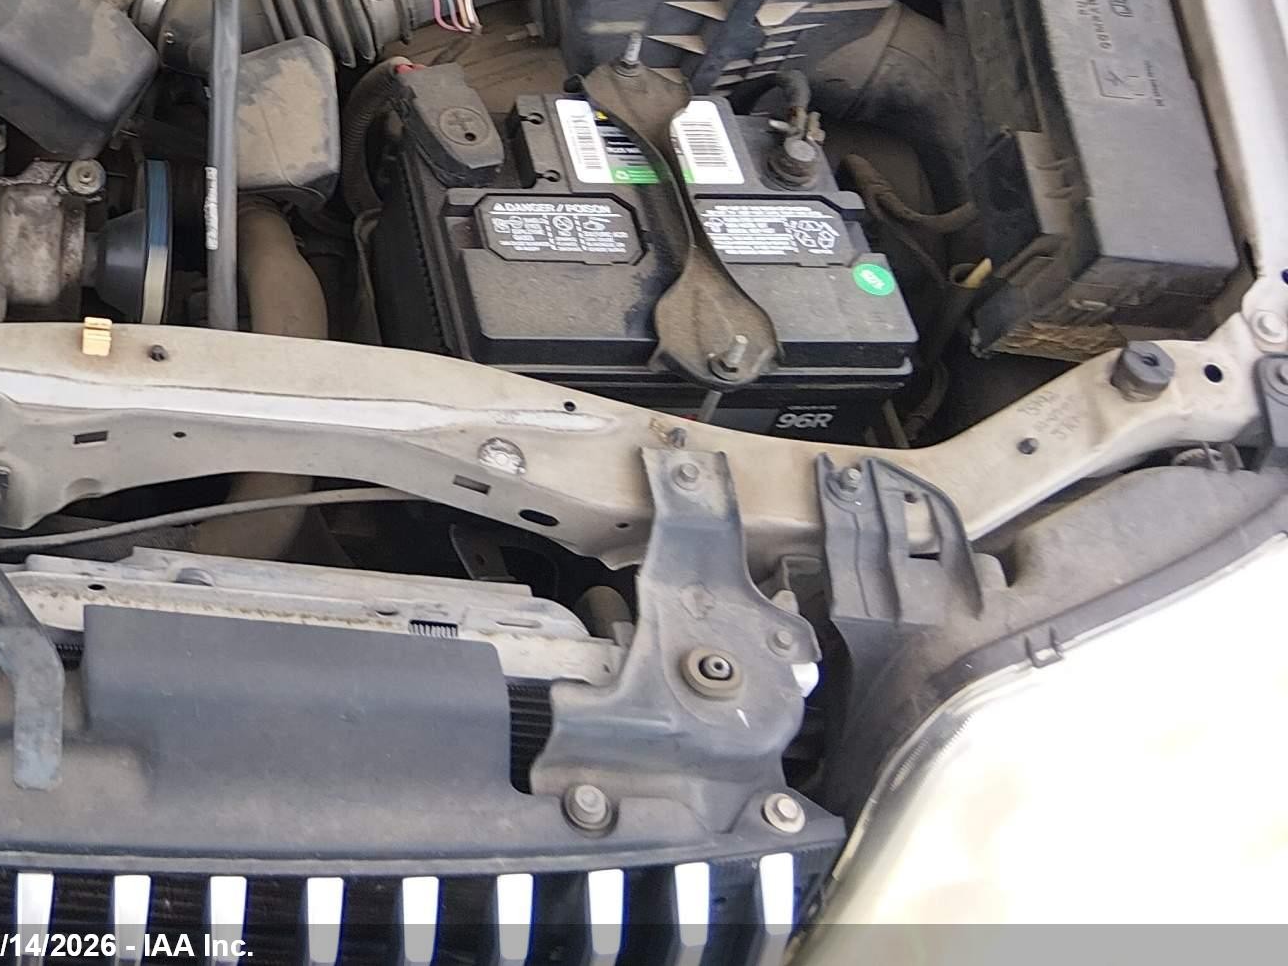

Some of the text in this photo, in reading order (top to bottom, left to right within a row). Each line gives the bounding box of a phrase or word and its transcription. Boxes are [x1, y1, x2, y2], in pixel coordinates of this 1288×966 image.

[504, 202, 556, 213] DANGER
[565, 203, 612, 214] POISON
[775, 412, 834, 429] 96R
